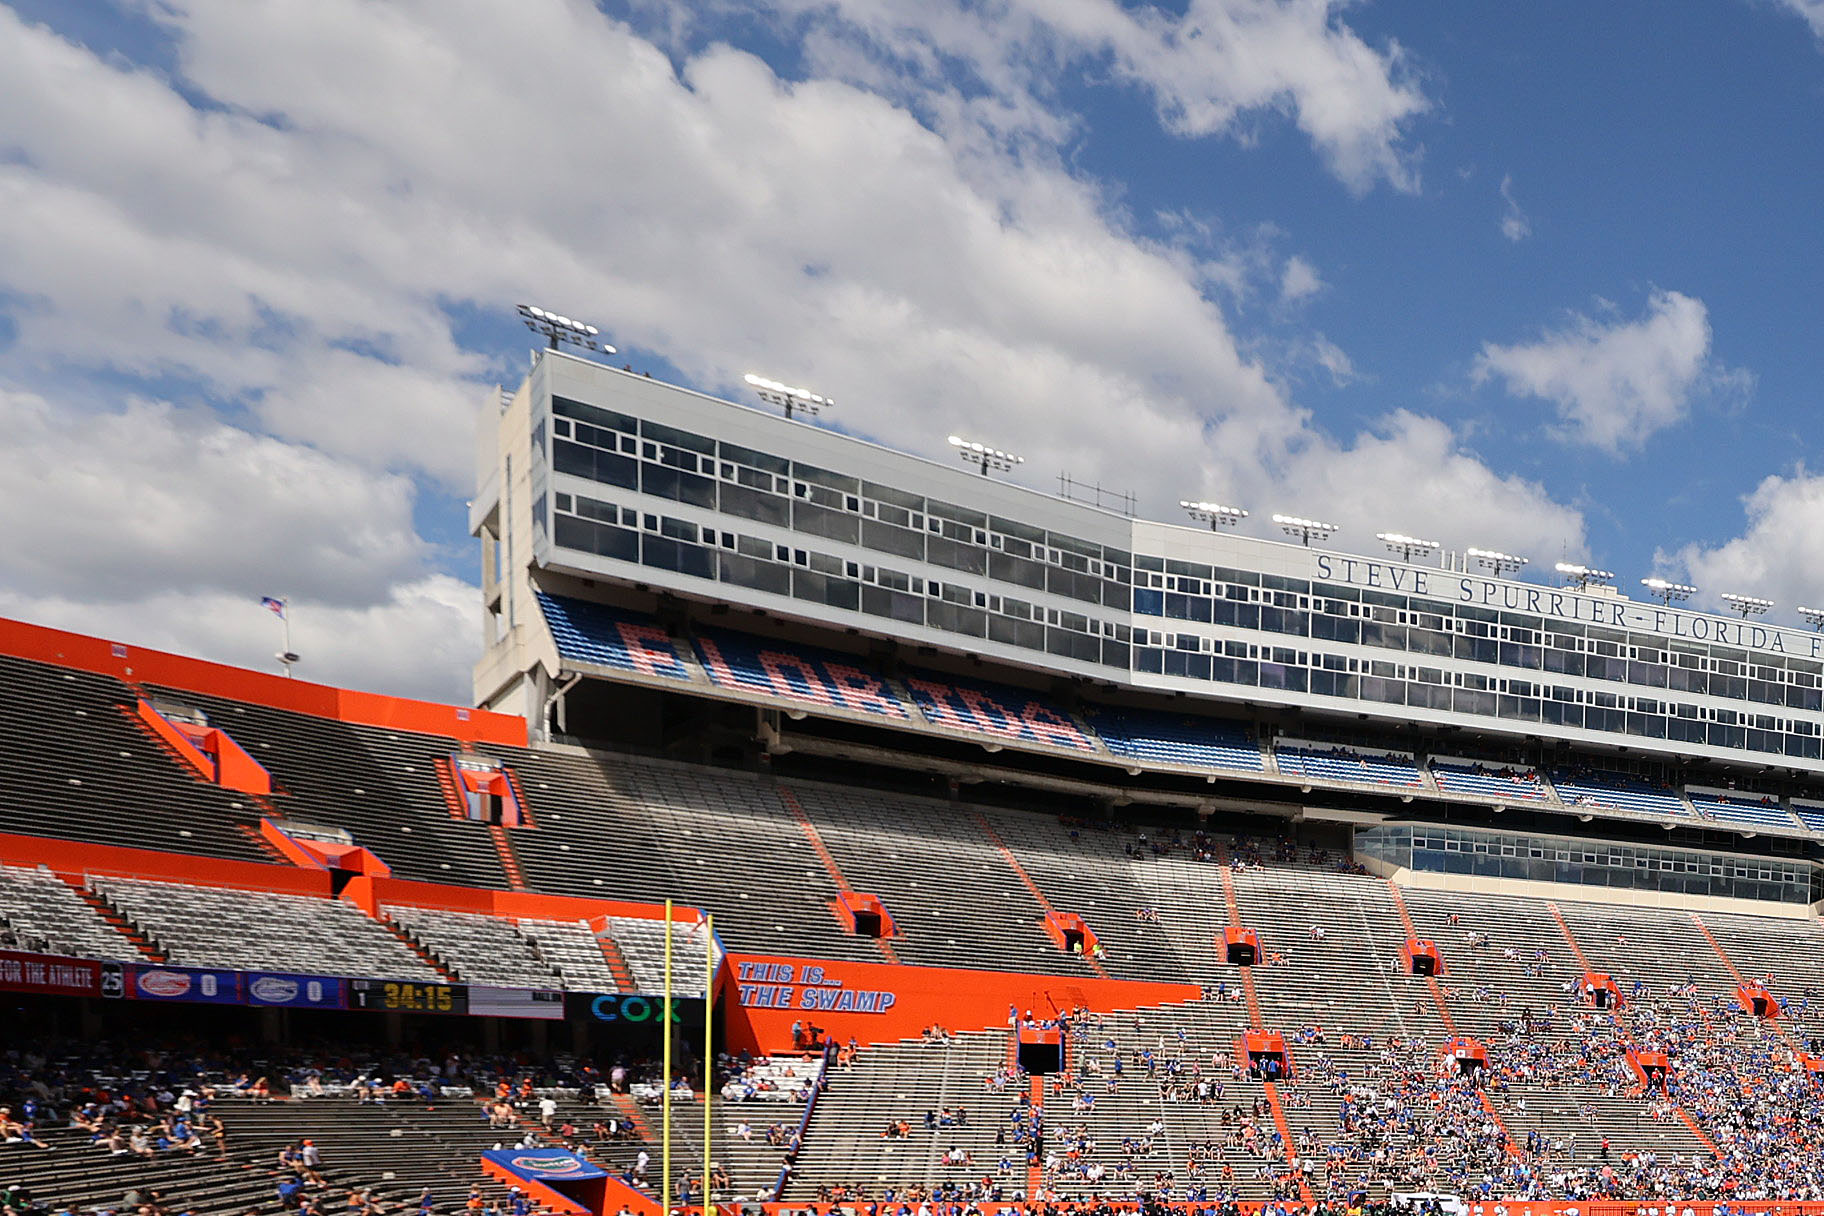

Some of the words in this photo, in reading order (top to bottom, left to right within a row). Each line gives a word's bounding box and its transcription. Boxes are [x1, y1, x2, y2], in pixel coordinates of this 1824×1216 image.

[1317, 555, 1428, 595] STEVE
[24, 961, 46, 984] THE
[49, 964, 93, 988] ATHLETE
[102, 972, 120, 990] 25
[201, 974, 218, 997] 0
[738, 962, 794, 982] THIS
[307, 980, 323, 1001] 0
[383, 983, 453, 1012] 34:15
[738, 984, 794, 1008] THE
[800, 987, 896, 1014] SWAMP
[591, 995, 682, 1024] COX
